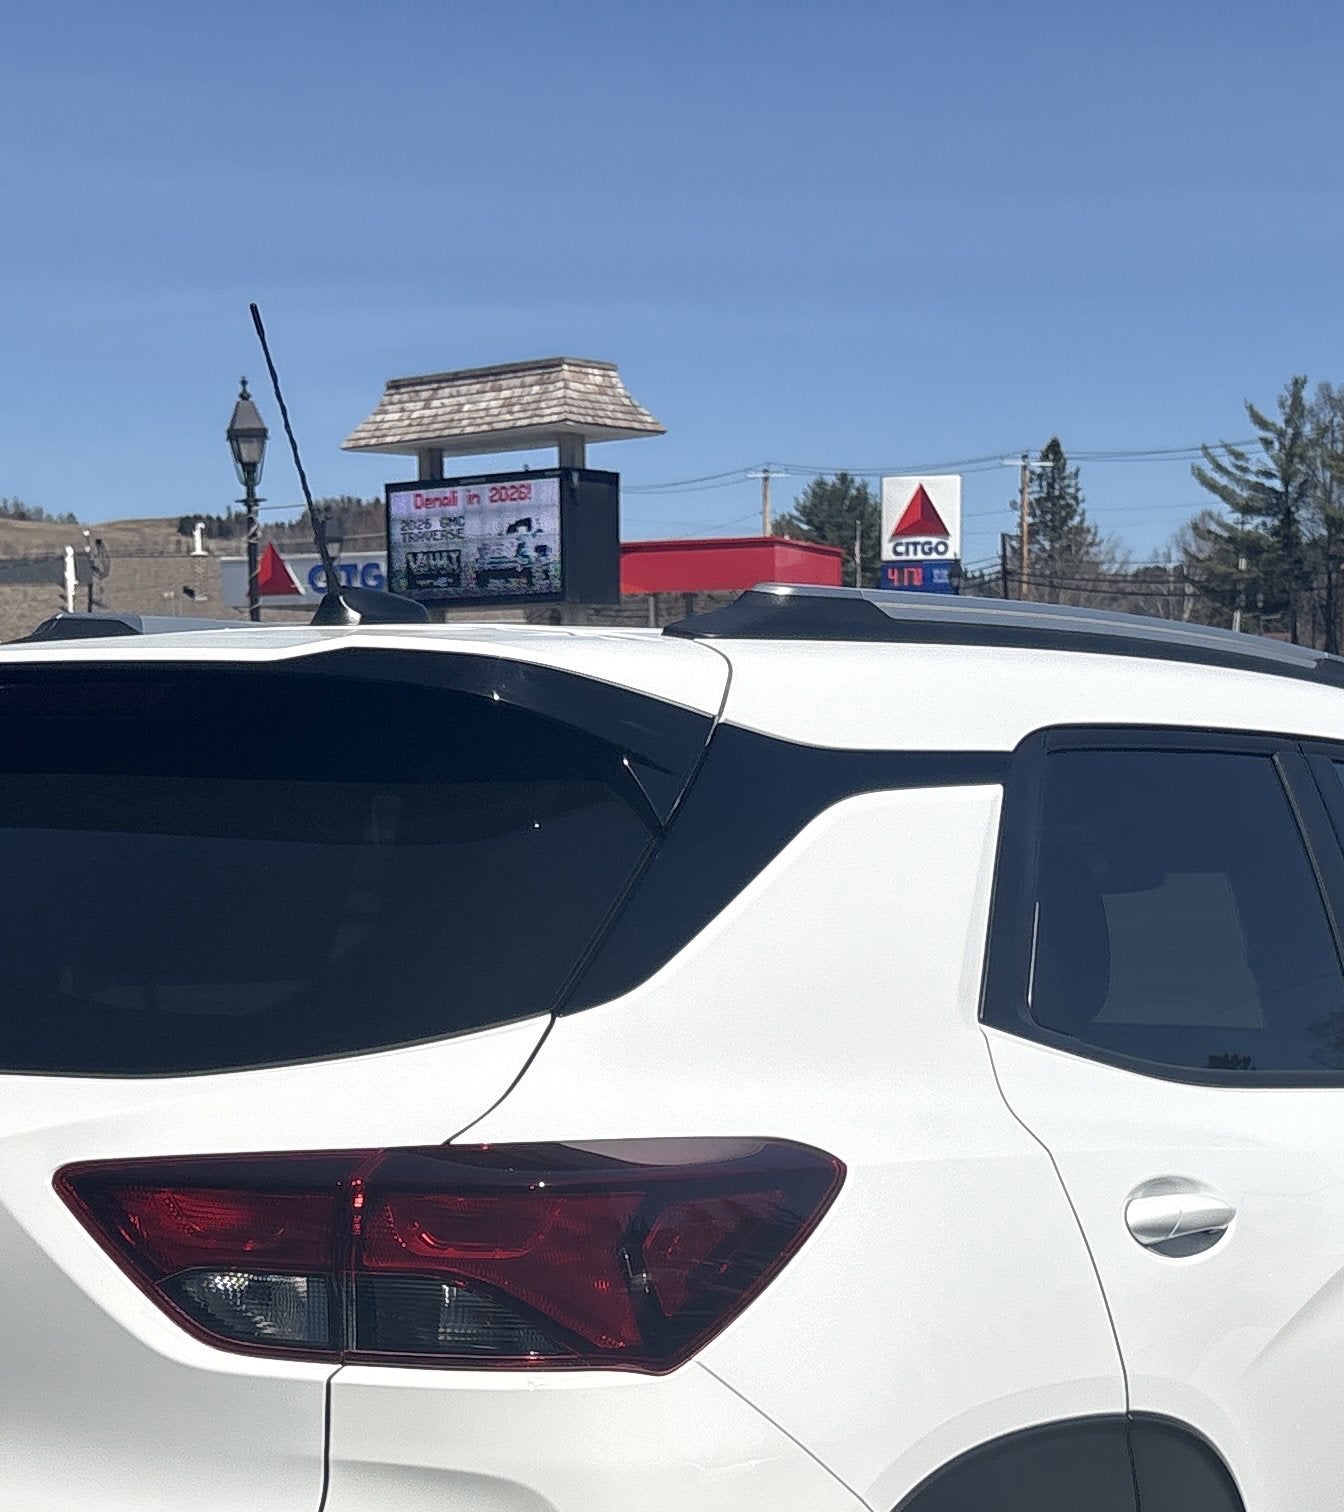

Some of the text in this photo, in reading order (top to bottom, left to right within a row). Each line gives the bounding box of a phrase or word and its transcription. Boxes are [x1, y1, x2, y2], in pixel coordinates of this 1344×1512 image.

[414, 489, 458, 510] Denali
[466, 489, 481, 505] in
[892, 541, 949, 557] CITGO
